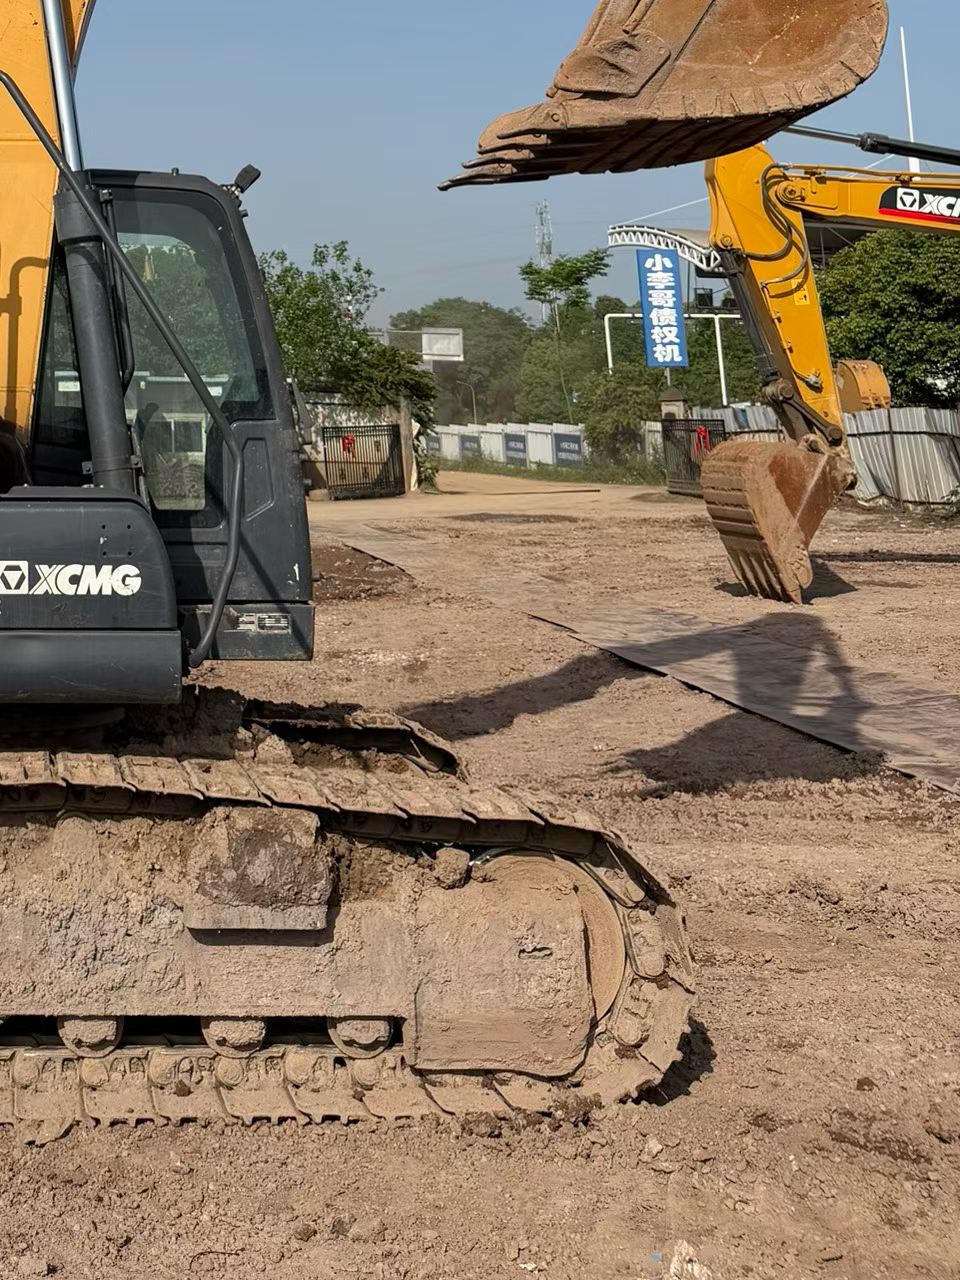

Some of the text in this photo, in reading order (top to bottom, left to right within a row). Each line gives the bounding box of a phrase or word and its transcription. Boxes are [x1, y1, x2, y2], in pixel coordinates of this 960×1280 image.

[643, 253, 682, 362] 小李哥债权机
[28, 563, 142, 597] XCMG
